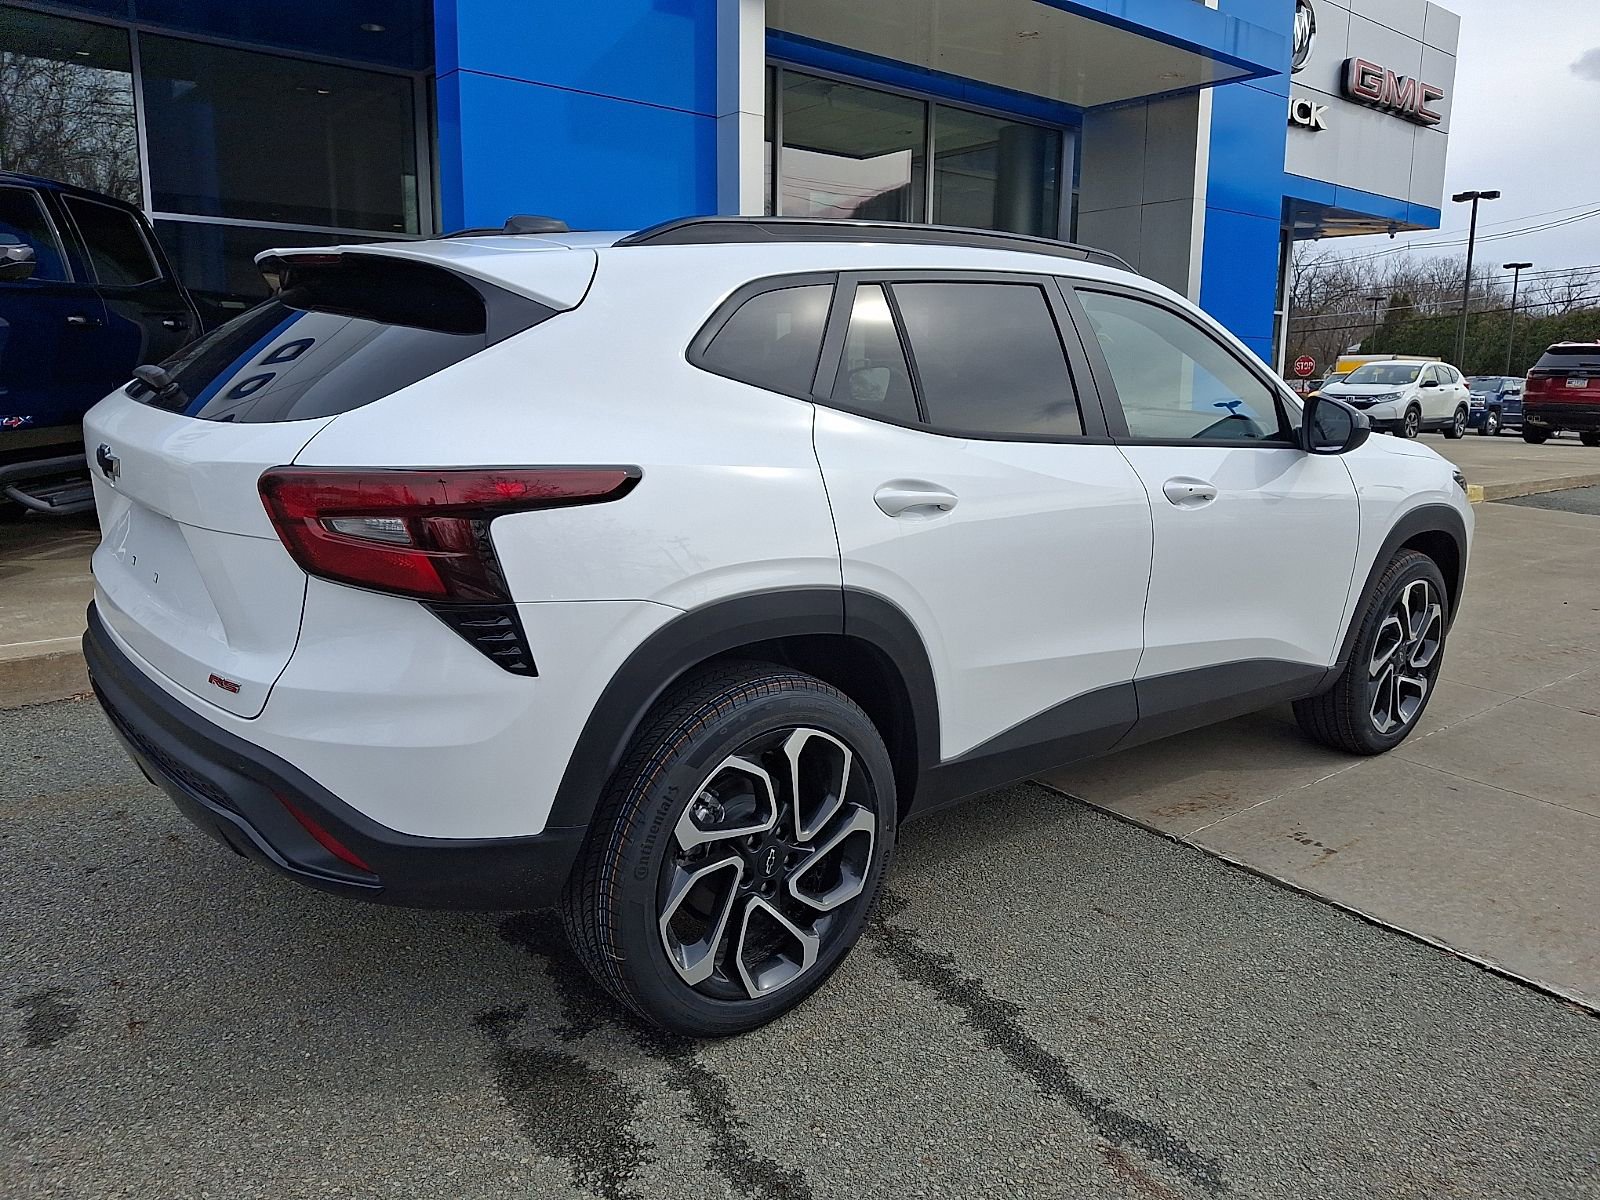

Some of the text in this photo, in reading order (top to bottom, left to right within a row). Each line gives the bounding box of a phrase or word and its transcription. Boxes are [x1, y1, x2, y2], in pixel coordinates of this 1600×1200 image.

[1344, 57, 1444, 126] GMC
[1296, 361, 1314, 371] STOP
[208, 672, 242, 694] RS
